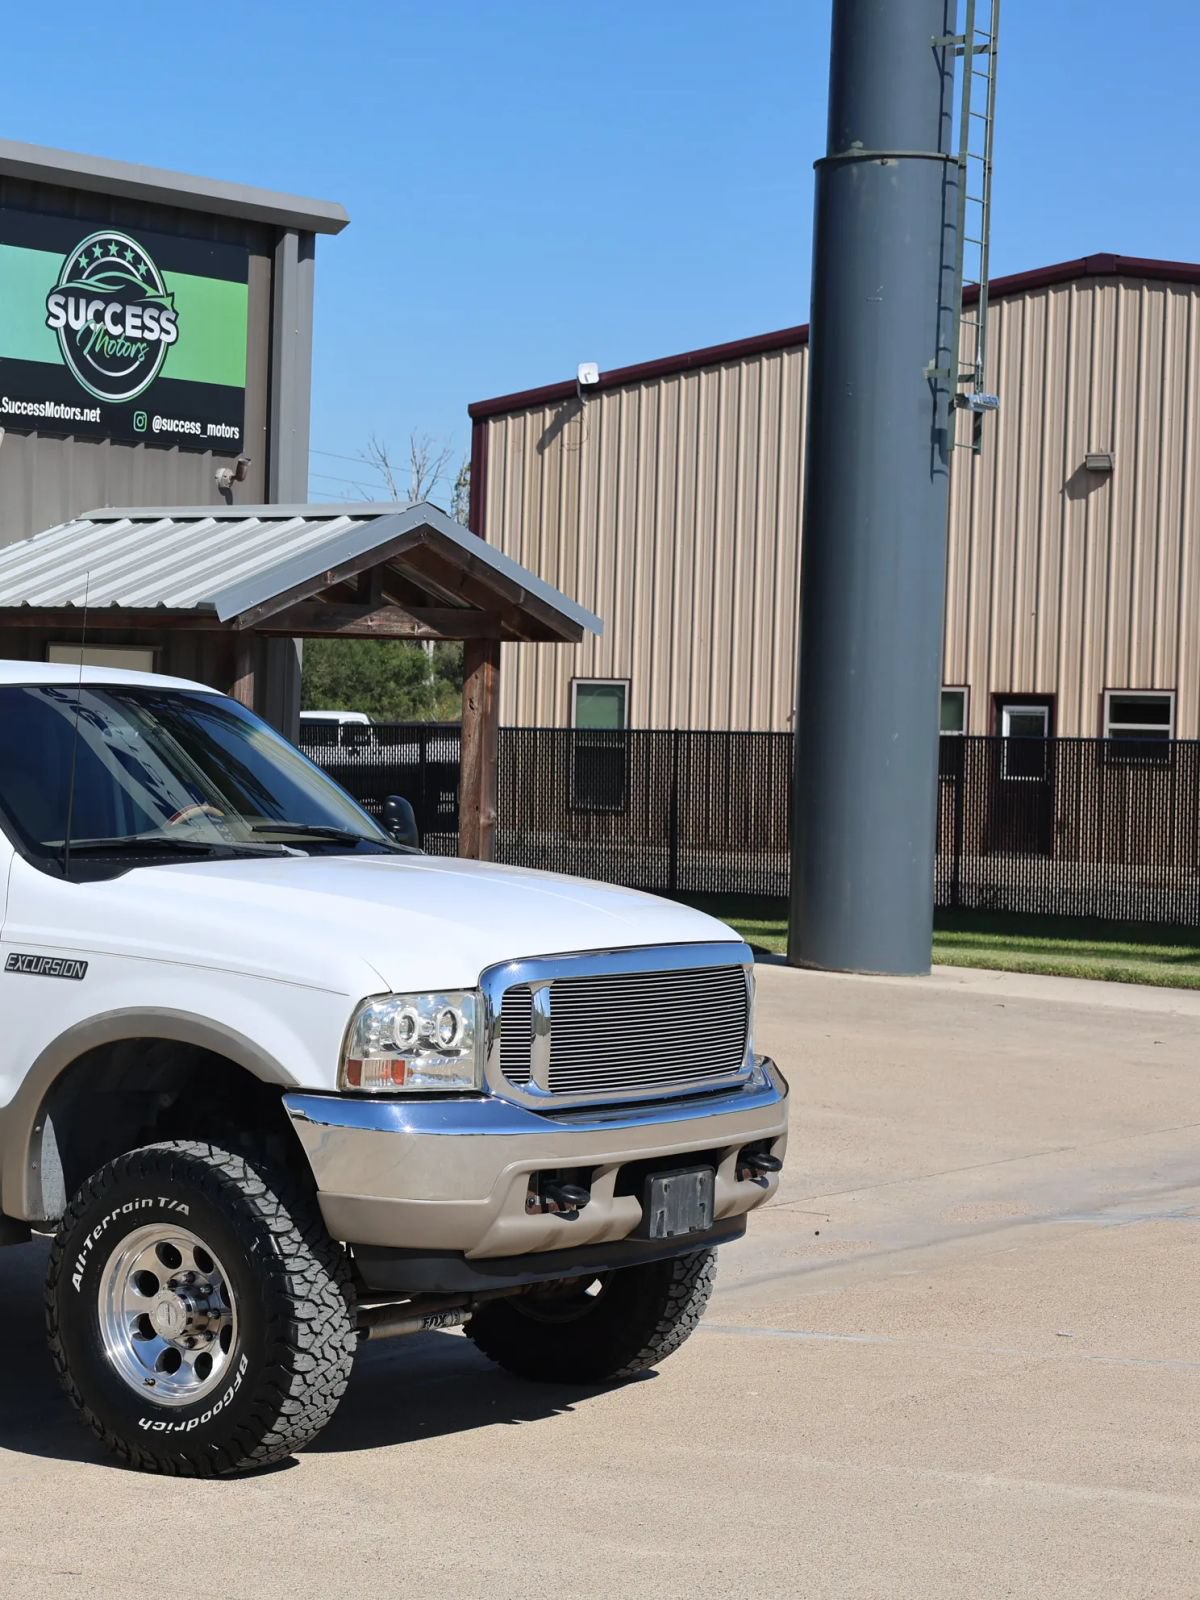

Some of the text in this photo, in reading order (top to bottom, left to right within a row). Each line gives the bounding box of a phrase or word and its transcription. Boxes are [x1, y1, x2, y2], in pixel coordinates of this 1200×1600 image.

[47, 294, 177, 343] SUCCESS
[76, 319, 150, 362] Motors
[152, 415, 240, 440] @success_motors
[5, 954, 86, 978] EXCURSION
[71, 1196, 190, 1292] All-Terrain T/A
[138, 1353, 249, 1434] BFGoodrich
